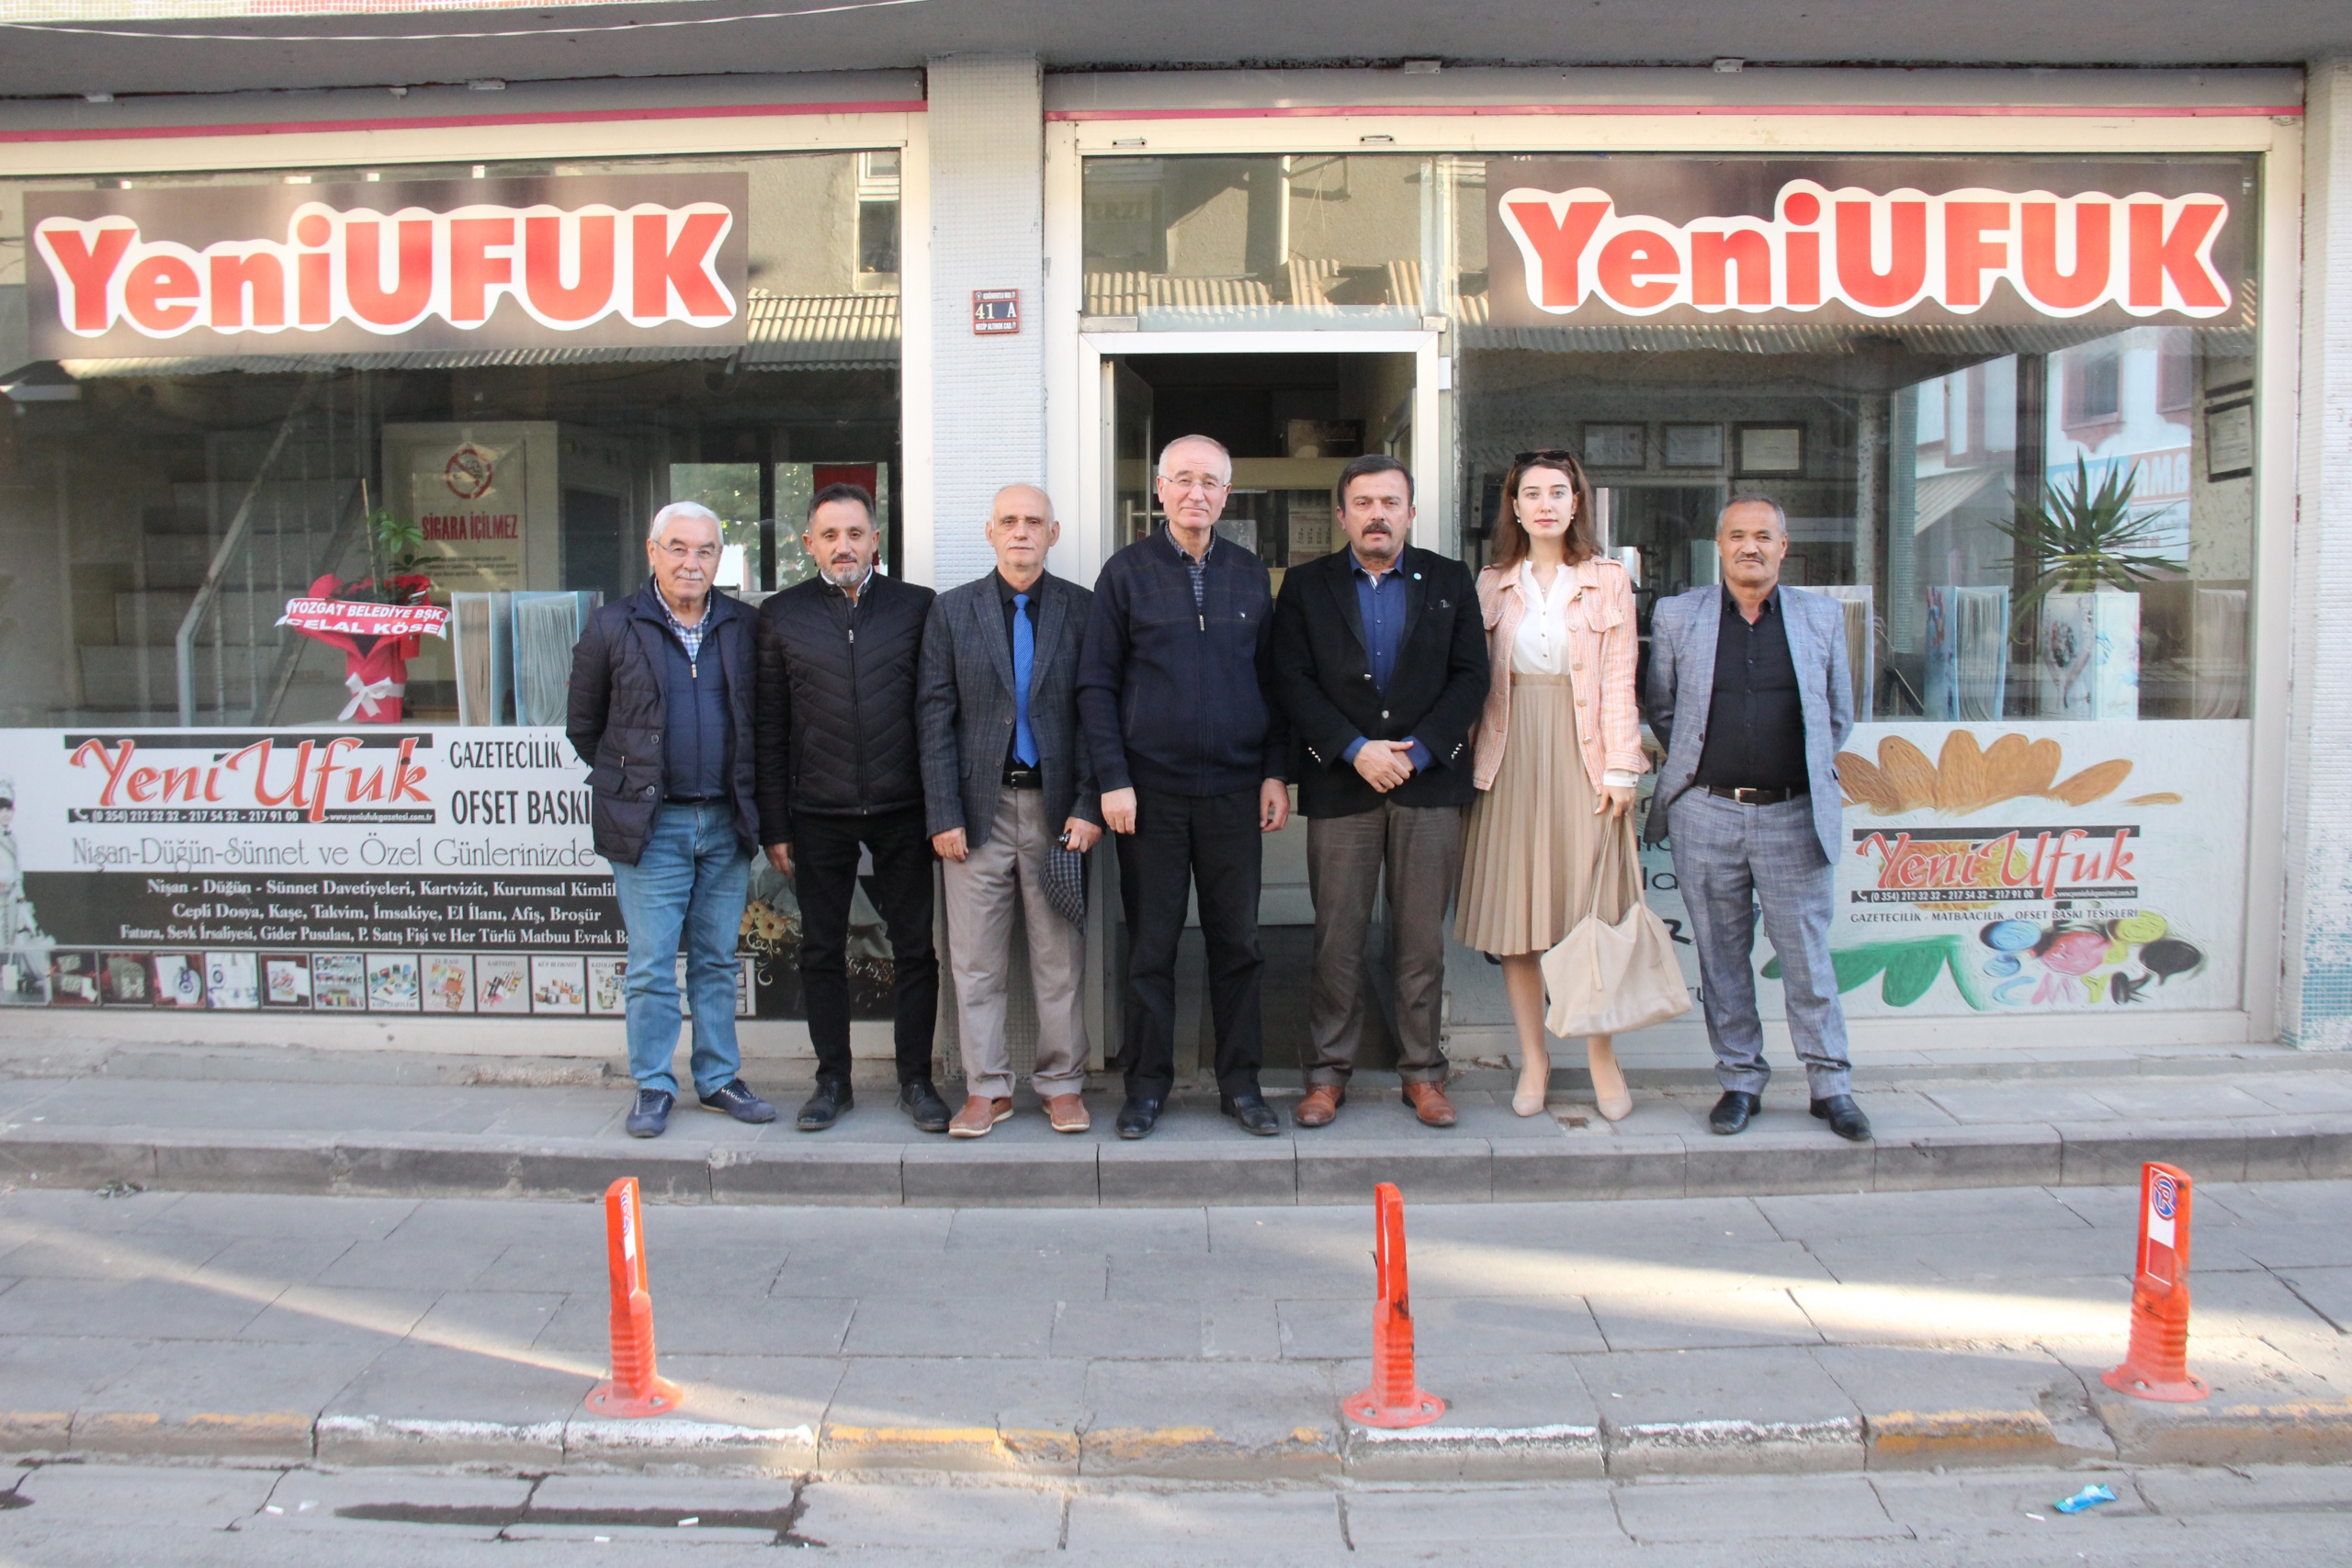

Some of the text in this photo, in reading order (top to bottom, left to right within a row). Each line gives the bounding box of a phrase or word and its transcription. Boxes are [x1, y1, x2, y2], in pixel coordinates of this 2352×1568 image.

[1507, 190, 2227, 309] YeniUFUK
[41, 212, 734, 331] YeniUFUK
[975, 301, 1017, 320] 41 A
[422, 511, 518, 543] SİGARA İÇİLMEZ
[291, 602, 445, 622] YOZGAT BELEDİYE BŞK.
[285, 618, 440, 635] CELAL KÖSE
[449, 733, 563, 769] GAZETECİLİK
[70, 737, 432, 823] Yeni Ufuk
[104, 810, 128, 823] 354)
[130, 810, 149, 822] 212
[151, 810, 164, 822] 32
[165, 810, 179, 822] 32
[188, 810, 208, 822] 217
[210, 810, 223, 822] 54
[225, 810, 239, 822] 32
[248, 810, 266, 822] 217
[270, 810, 283, 822] 91
[285, 810, 299, 822] 00
[451, 789, 590, 826] OFSET BASKI
[319, 846, 349, 866] ve
[359, 831, 423, 866] Özel
[434, 837, 596, 867] Günlerinizde
[1855, 828, 2136, 899] Yeni Ufuk
[147, 878, 188, 897] Nişan
[202, 878, 252, 897] Düğün
[266, 879, 319, 895] Sünnet
[322, 879, 416, 898] Davetiyeleri,
[419, 880, 489, 897] Kartvizit,
[492, 881, 566, 897] Kurumsal
[1881, 891, 1900, 902] 354)
[1901, 891, 1915, 901] 212
[1917, 891, 1928, 900] 32
[1929, 891, 1940, 900] 32
[1948, 890, 1962, 900] 217
[1964, 890, 1975, 900] 54
[1976, 890, 1987, 900] 32
[1995, 888, 2009, 899] 217
[2011, 888, 2021, 898] 91
[2023, 888, 2034, 898] 00
[172, 902, 602, 925] Cepli Dosya, Kaşe, Takvim, İmsakiye, El İlanı, Afiş, Broşür
[1850, 910, 1922, 923] GAZETECİLİK
[1931, 910, 2005, 921] MATBAACILIK
[2015, 910, 2049, 920] OFSET
[2052, 910, 2083, 919] BASKI
[119, 923, 164, 942] Fatura,
[166, 924, 198, 940] Sevk
[199, 922, 258, 942] İrsaliyesi,
[260, 925, 298, 941] Gider
[300, 926, 355, 943] Pusulası,
[357, 927, 369, 941] P.
[372, 927, 403, 945] Satış
[406, 927, 429, 945] Fişi
[432, 931, 447, 942] ve
[449, 928, 476, 942] Her
[479, 928, 516, 943] Türlü
[520, 929, 571, 943] Matbuu
[574, 929, 613, 943] Evrak
